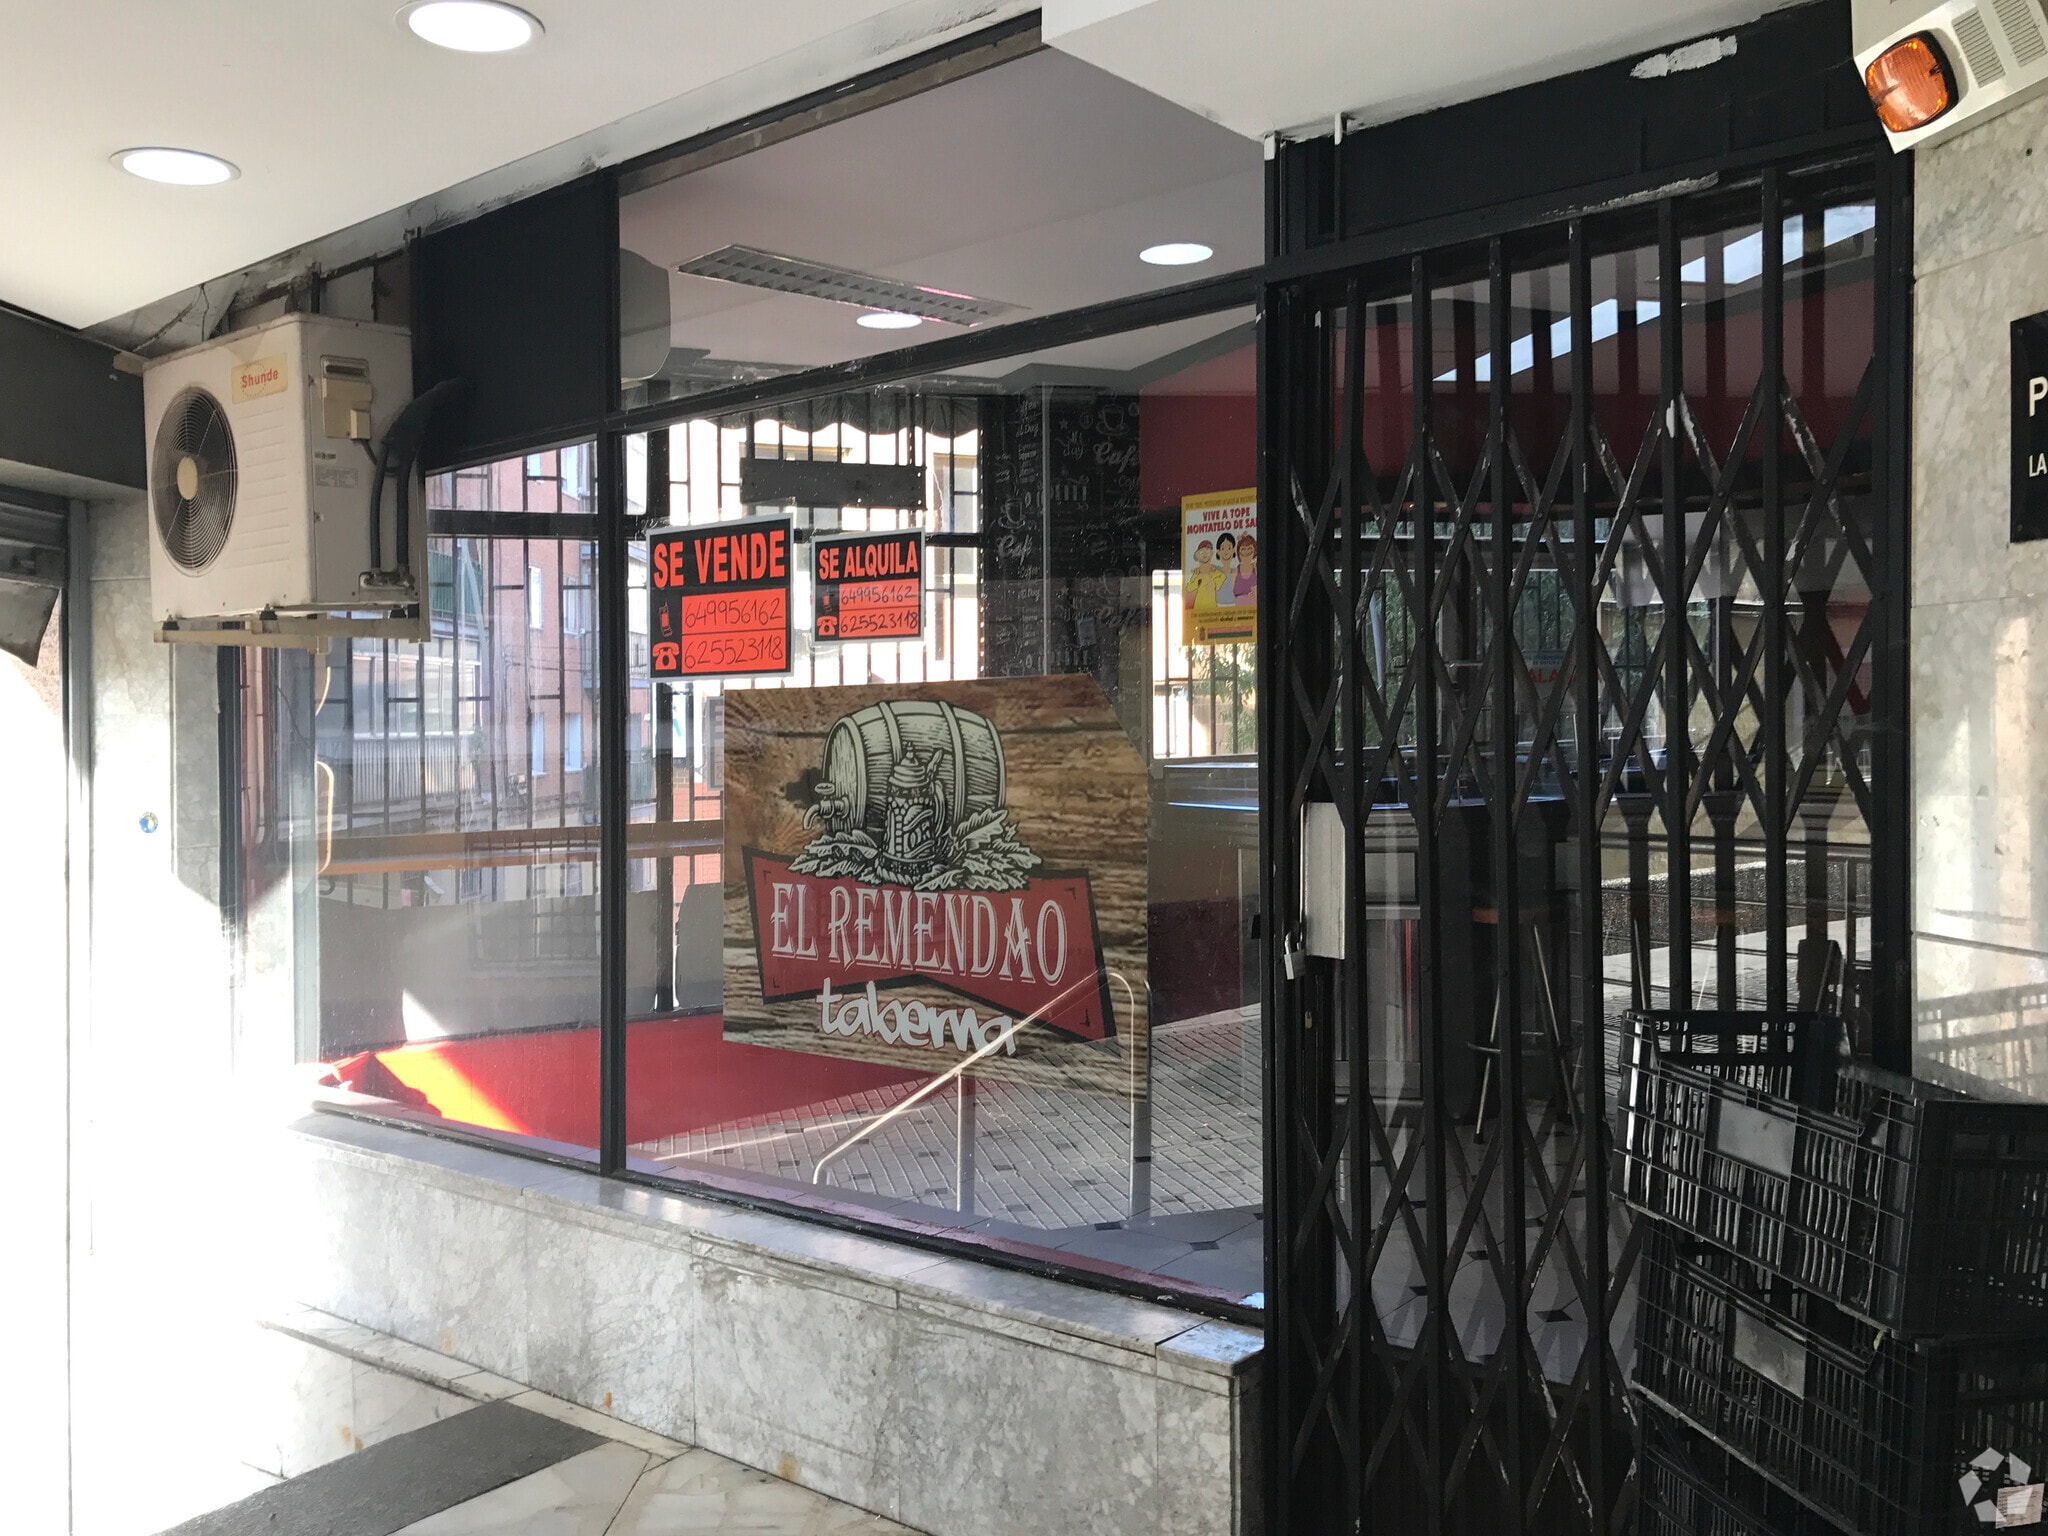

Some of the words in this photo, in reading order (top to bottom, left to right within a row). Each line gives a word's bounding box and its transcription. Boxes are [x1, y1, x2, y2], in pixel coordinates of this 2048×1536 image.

[240, 368, 279, 389] Shunde
[1203, 510, 1220, 521] VIVE
[1222, 509, 1228, 519] A
[1230, 507, 1250, 518] TOPE
[1233, 519, 1244, 529] DE
[653, 541, 684, 589] SE
[694, 529, 785, 584] VENDE
[818, 547, 839, 580] SE
[844, 540, 918, 579] ALQUILA
[841, 585, 918, 605] 649956162
[685, 597, 783, 628] 649956162
[840, 610, 919, 633] 625523118
[684, 636, 783, 669] 625523118
[770, 881, 818, 960] EL
[828, 884, 1068, 986] REMENDAO
[816, 977, 1016, 1057] taberna
